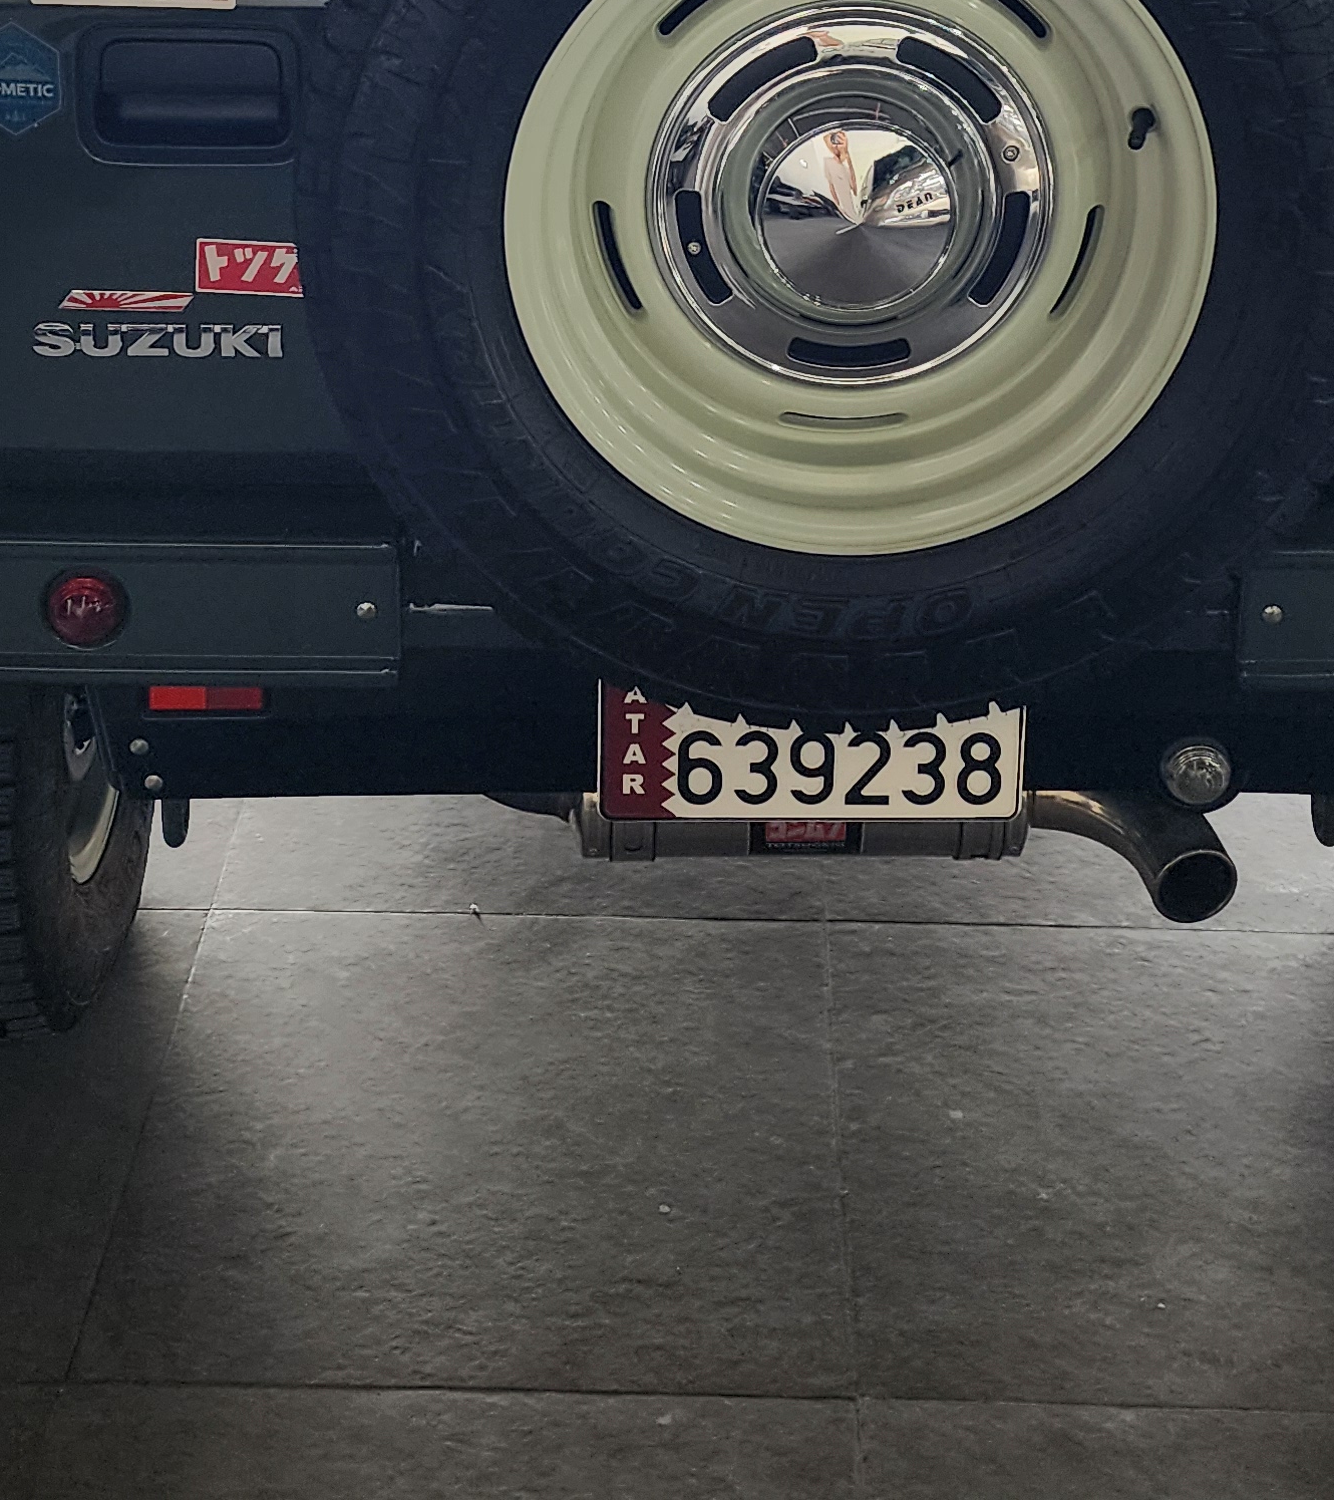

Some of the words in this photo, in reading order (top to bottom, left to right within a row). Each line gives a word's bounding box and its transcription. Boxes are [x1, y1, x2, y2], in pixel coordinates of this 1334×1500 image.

[32, 323, 284, 359] SUZUKI
[621, 686, 647, 796] ATAR
[676, 729, 1003, 807] 639238
